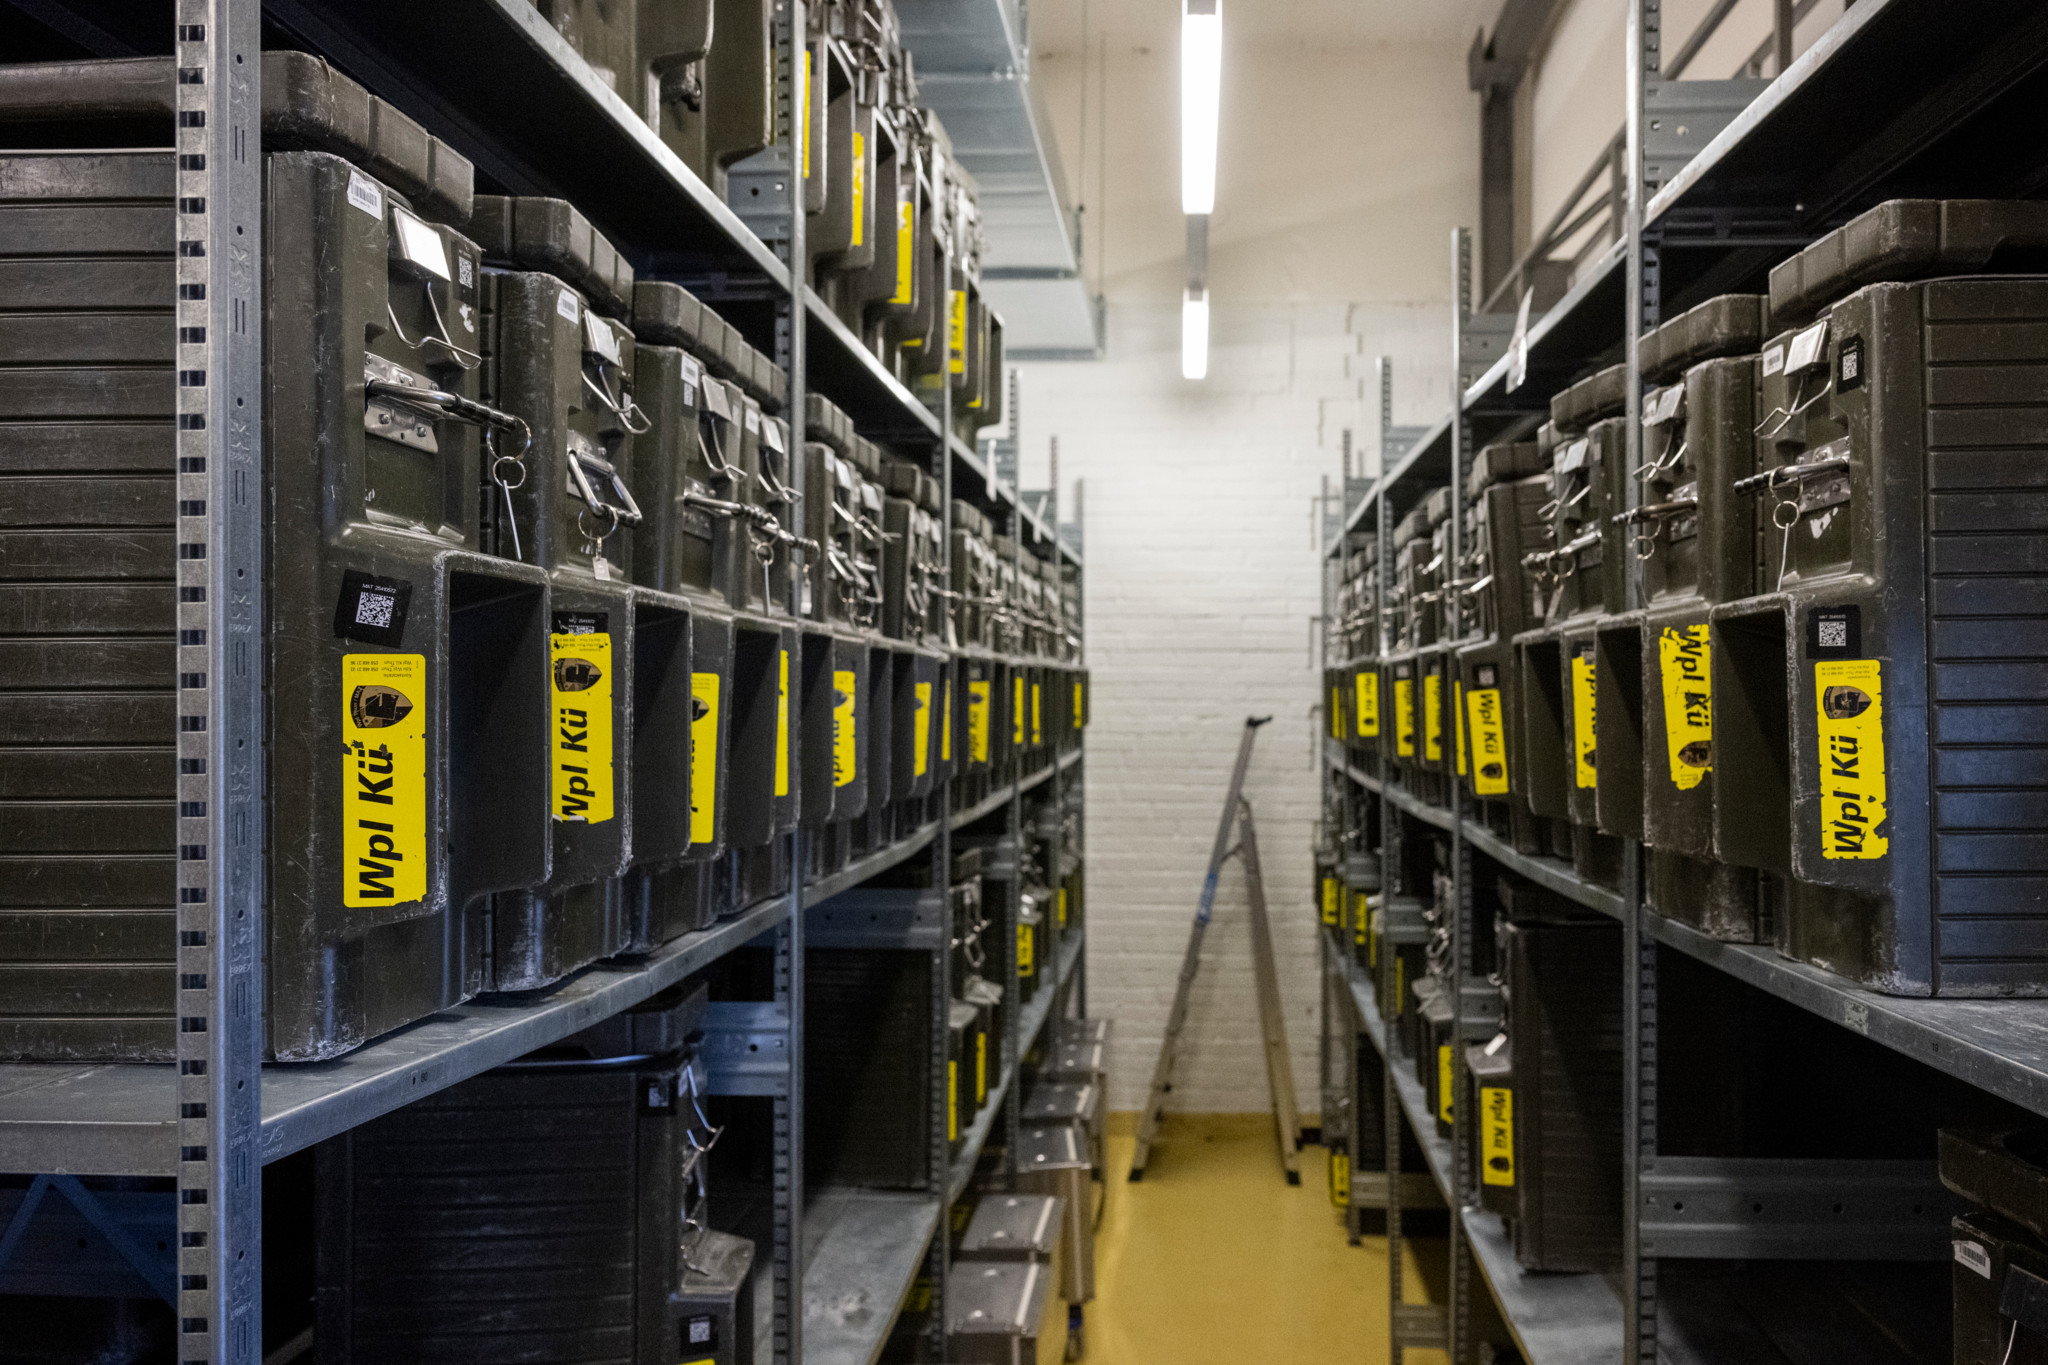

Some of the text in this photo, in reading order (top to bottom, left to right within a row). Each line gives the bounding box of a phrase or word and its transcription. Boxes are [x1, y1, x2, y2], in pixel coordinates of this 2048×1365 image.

[1477, 693, 1499, 754] Wpl Kü
[1676, 631, 1709, 727] Wpl Kü
[560, 708, 596, 823] Wpl Kü
[1830, 735, 1869, 853] Wpl Kü
[358, 749, 403, 899] Wpl Kü
[1489, 1091, 1508, 1149] Wpl Kü
